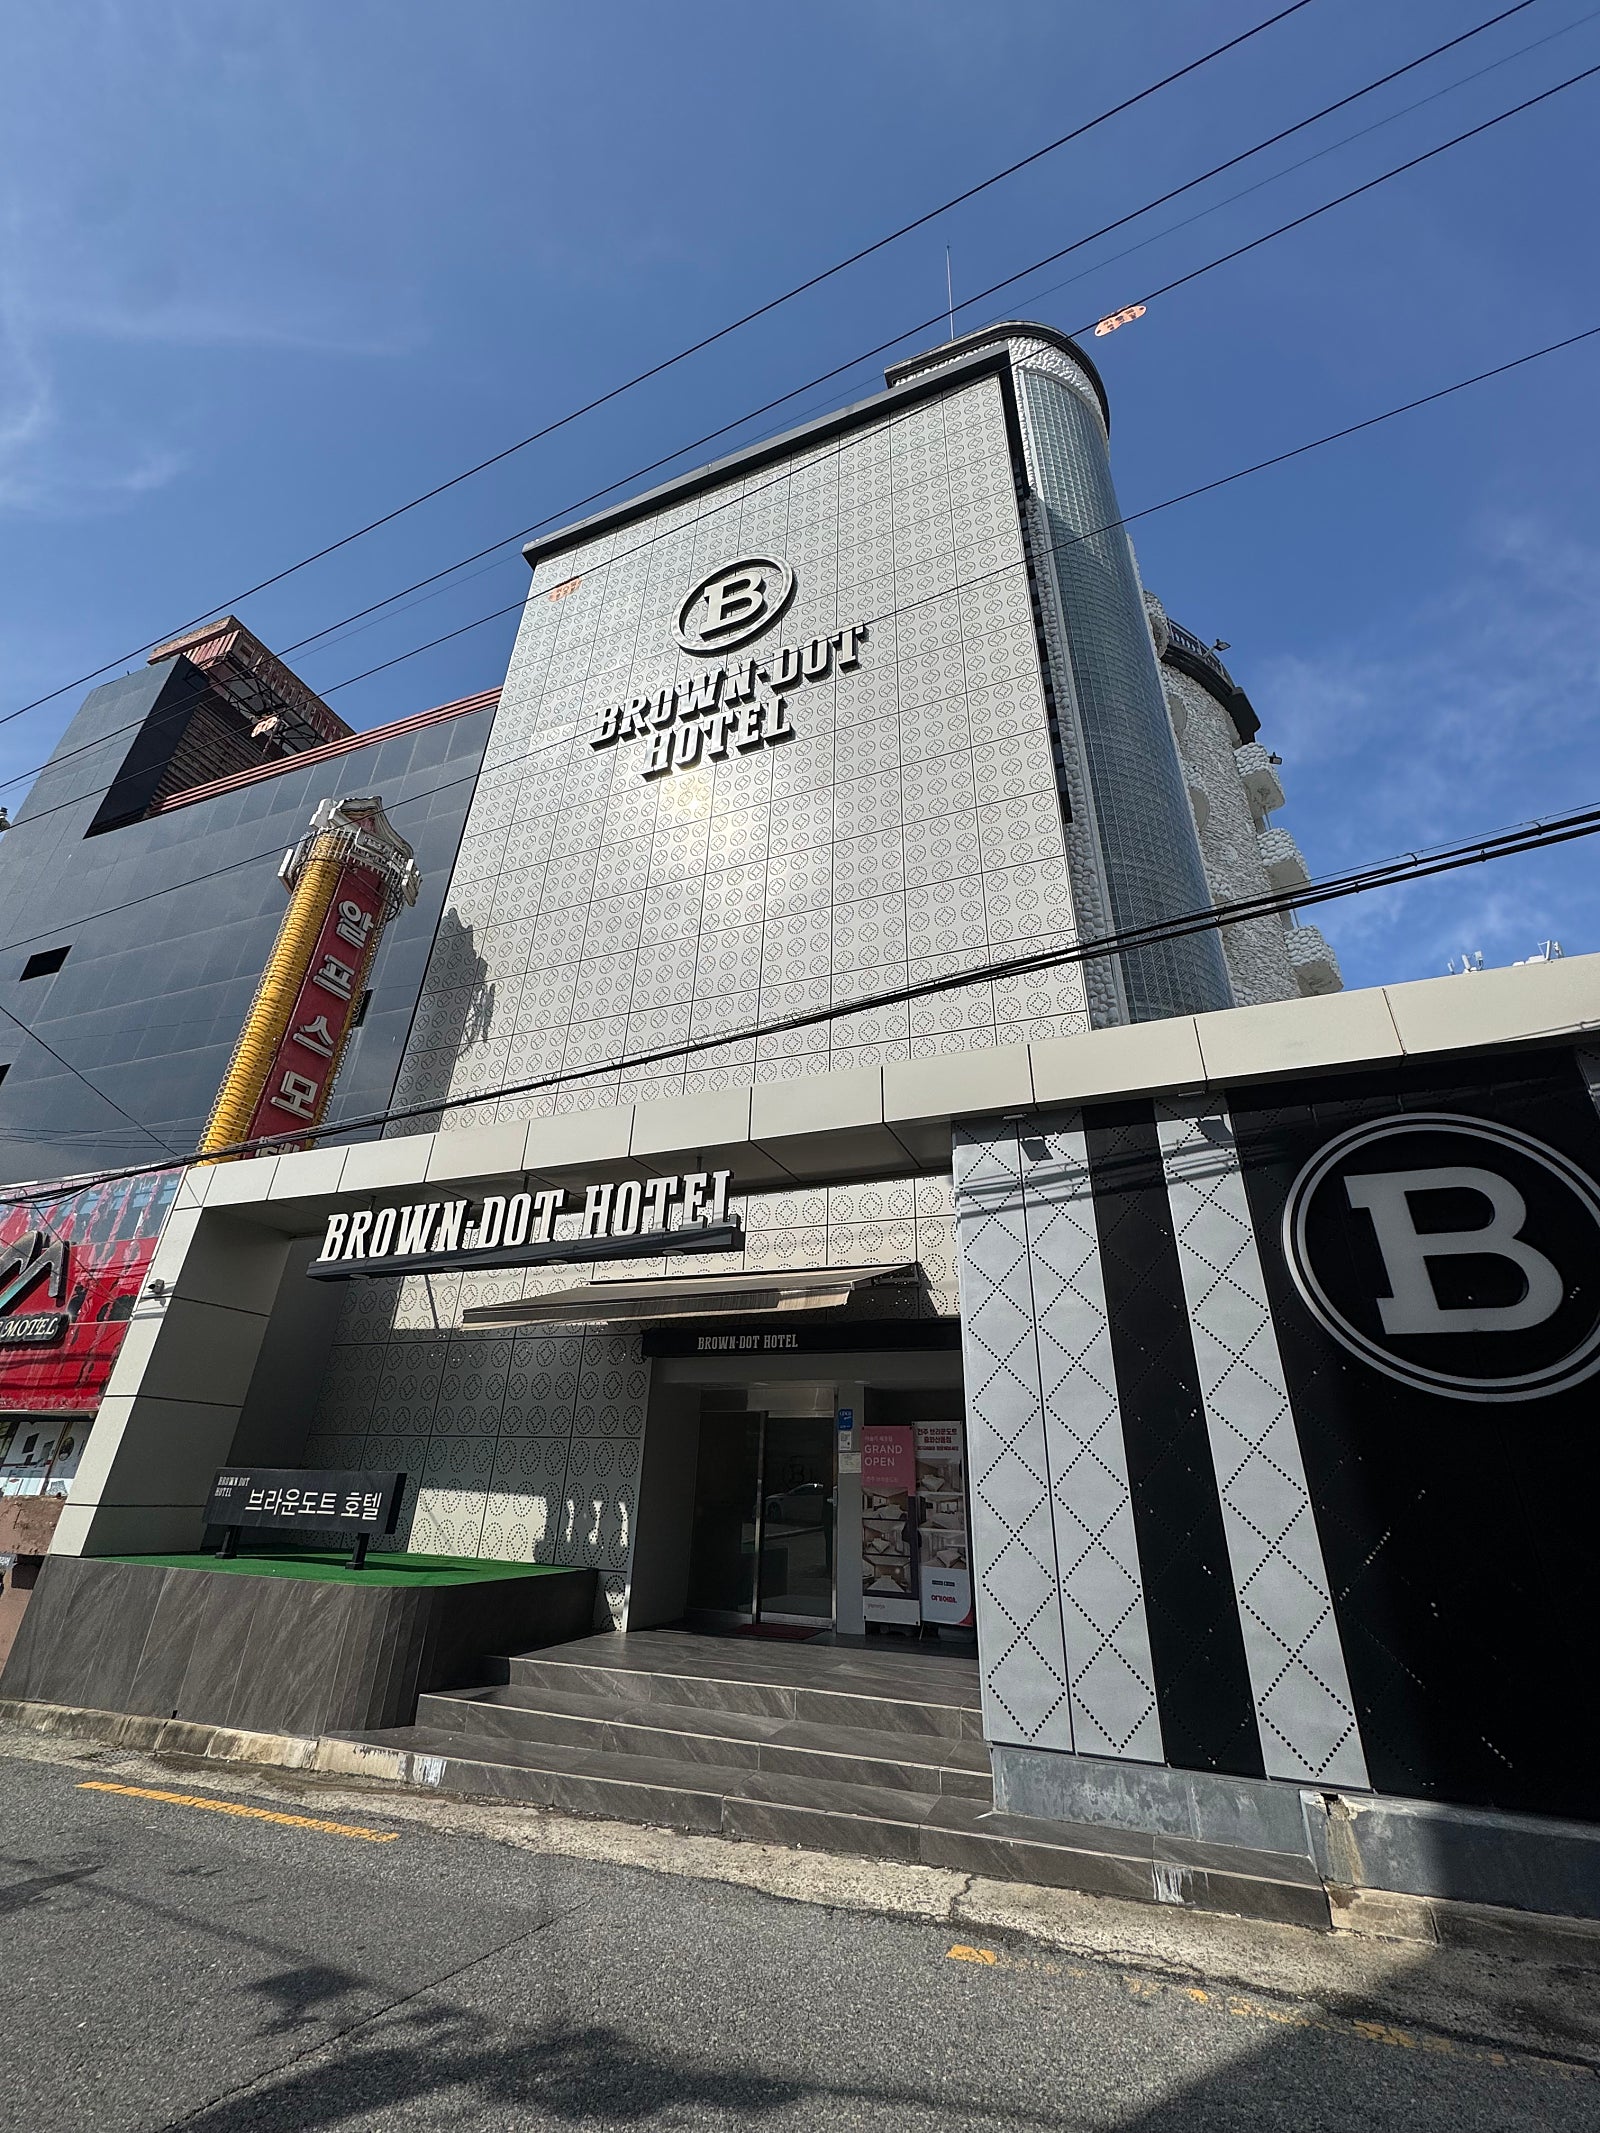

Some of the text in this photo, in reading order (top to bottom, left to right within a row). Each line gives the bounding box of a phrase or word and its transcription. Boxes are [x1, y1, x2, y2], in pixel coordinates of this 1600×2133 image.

[700, 571, 767, 638] B
[640, 695, 793, 777] HOTEL
[580, 1170, 737, 1240] HOTEL
[1344, 1166, 1564, 1335] B
[1, 1317, 58, 1338] MOTEL
[763, 1334, 798, 1349] HOTEL
[864, 1444, 903, 1454] GRAND
[864, 1456, 895, 1466] OPEN
[245, 1488, 383, 1521] 브라운도트 호텔
